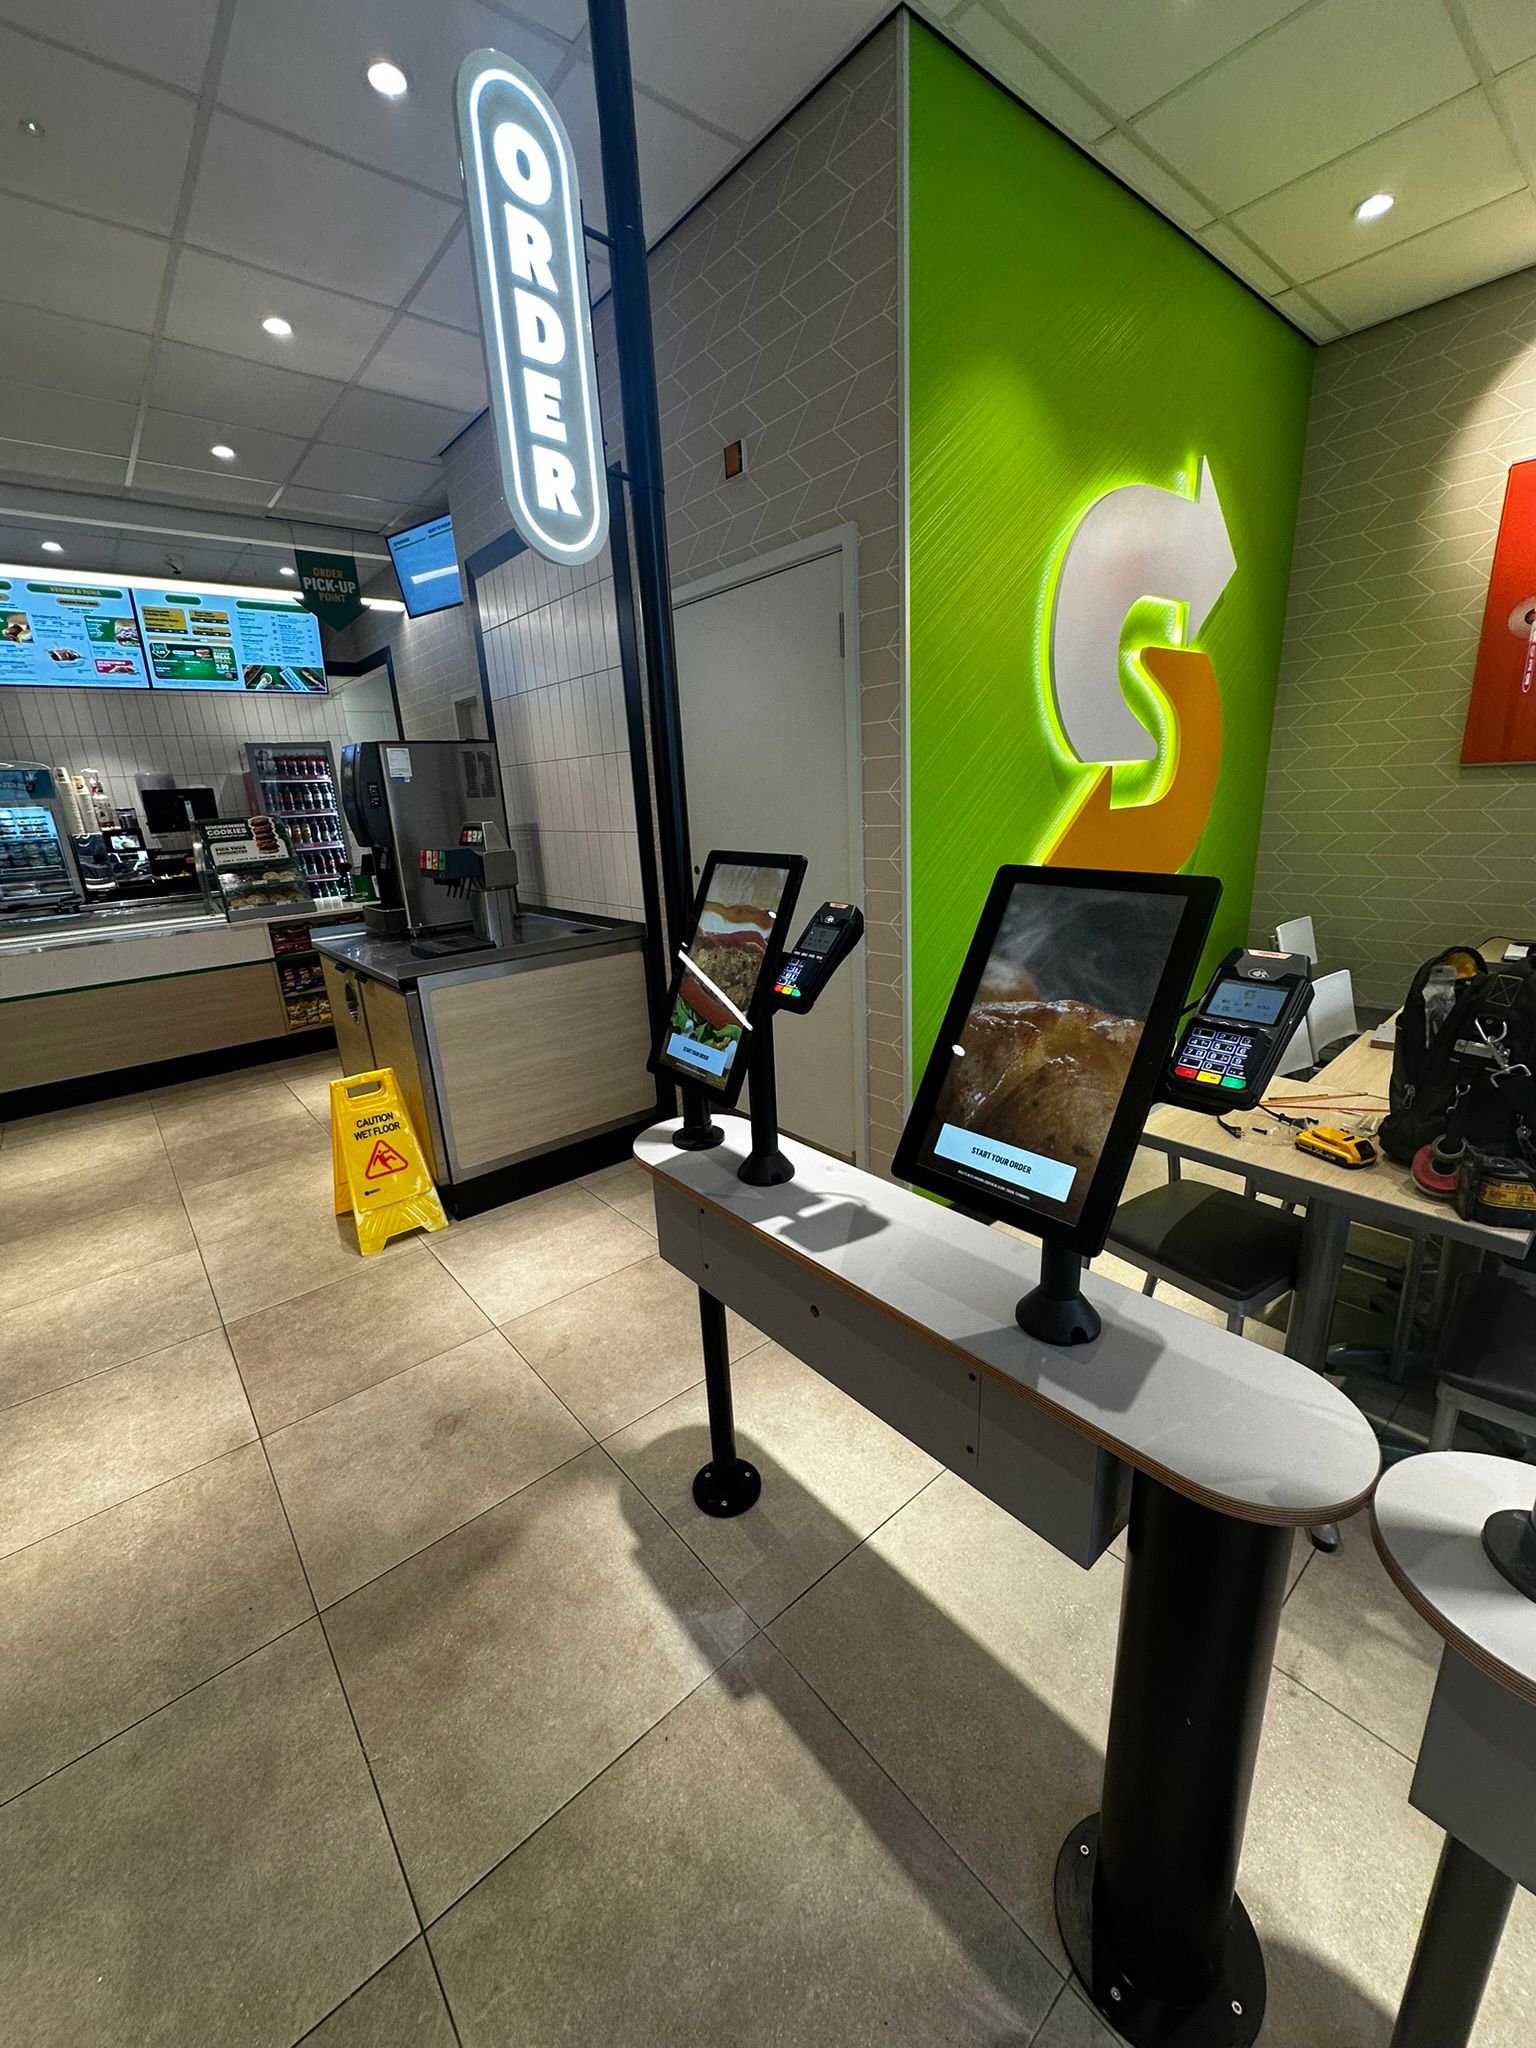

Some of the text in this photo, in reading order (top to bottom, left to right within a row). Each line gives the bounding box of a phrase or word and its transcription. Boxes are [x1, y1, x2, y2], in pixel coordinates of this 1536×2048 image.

[493, 121, 582, 517] ORDER
[313, 567, 343, 580] ORDER
[48, 585, 76, 594] VEGGIE
[302, 576, 356, 594] PICK-UP
[319, 591, 346, 603] POINT
[206, 827, 248, 837] COOKIES
[356, 1111, 394, 1129] CAUTION
[354, 1121, 401, 1140] WET FLOOR
[971, 1147, 1032, 1174] START YOUR ORDER
